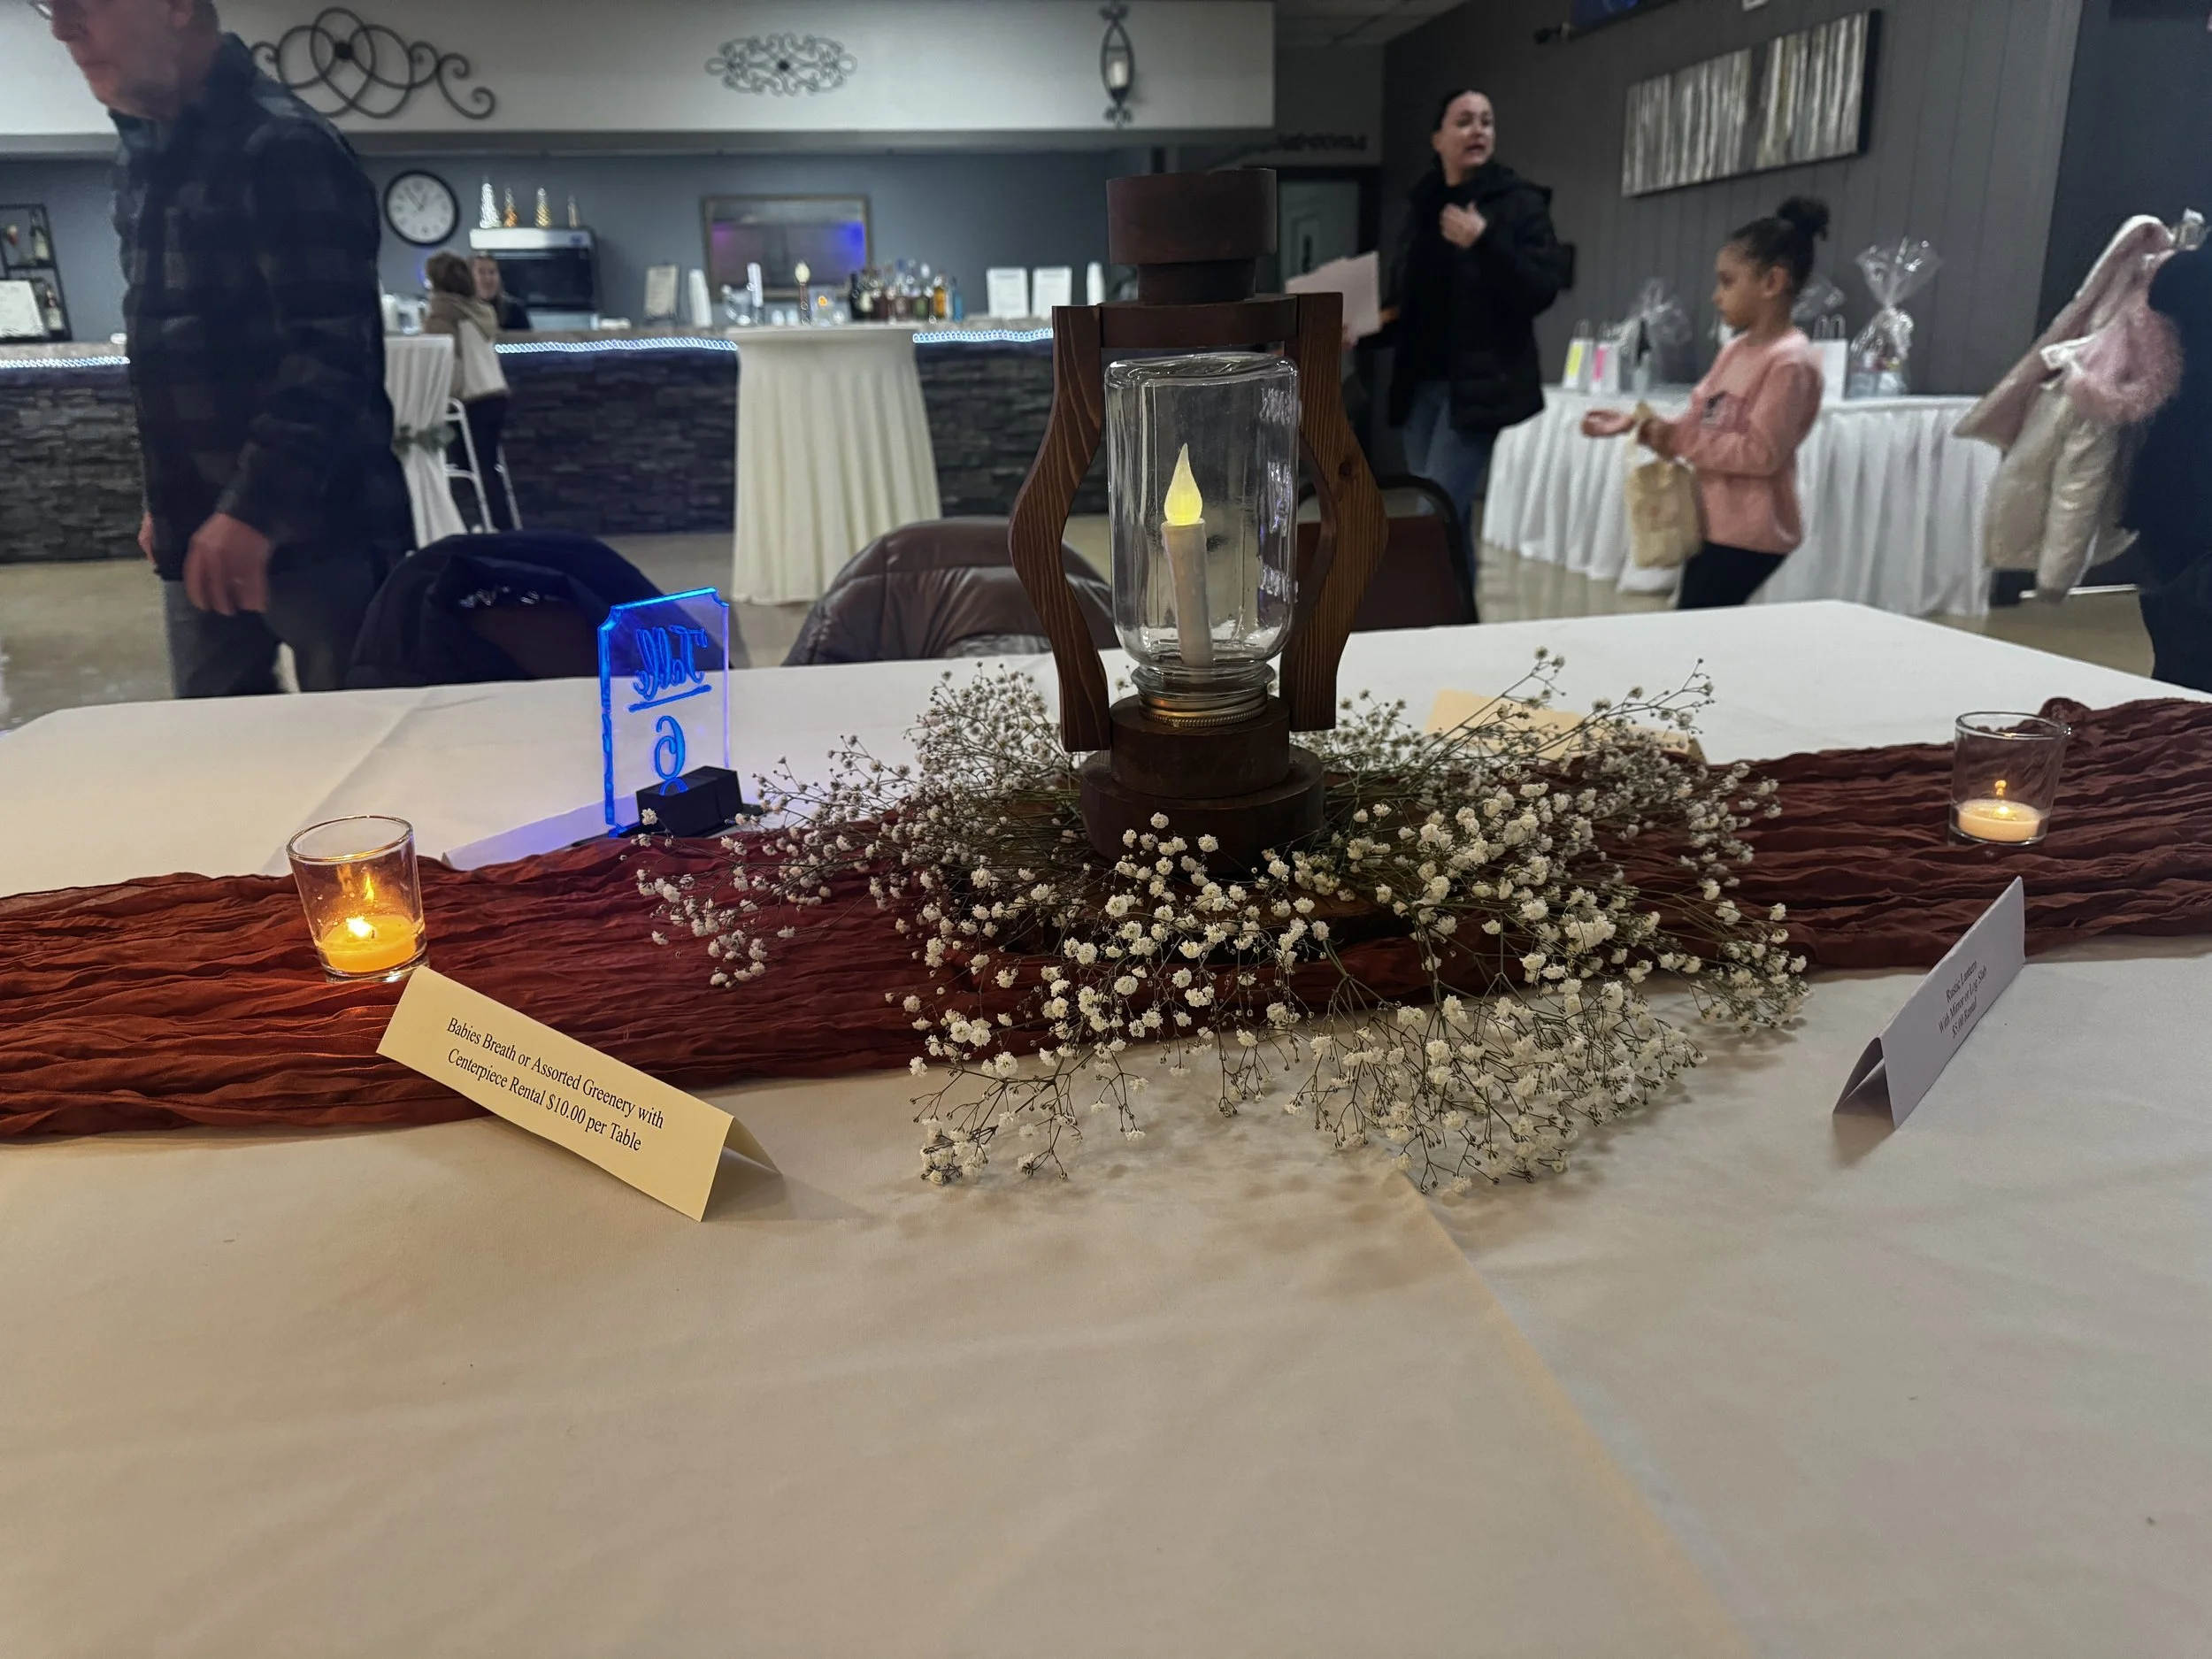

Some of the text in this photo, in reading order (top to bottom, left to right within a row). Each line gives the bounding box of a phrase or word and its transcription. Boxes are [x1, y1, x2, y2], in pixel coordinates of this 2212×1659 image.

[447, 1018, 664, 1129] Babies Breath or Assorted Greenery with
[448, 1048, 641, 1151] Centerpiece Rental $10.00 per Table
